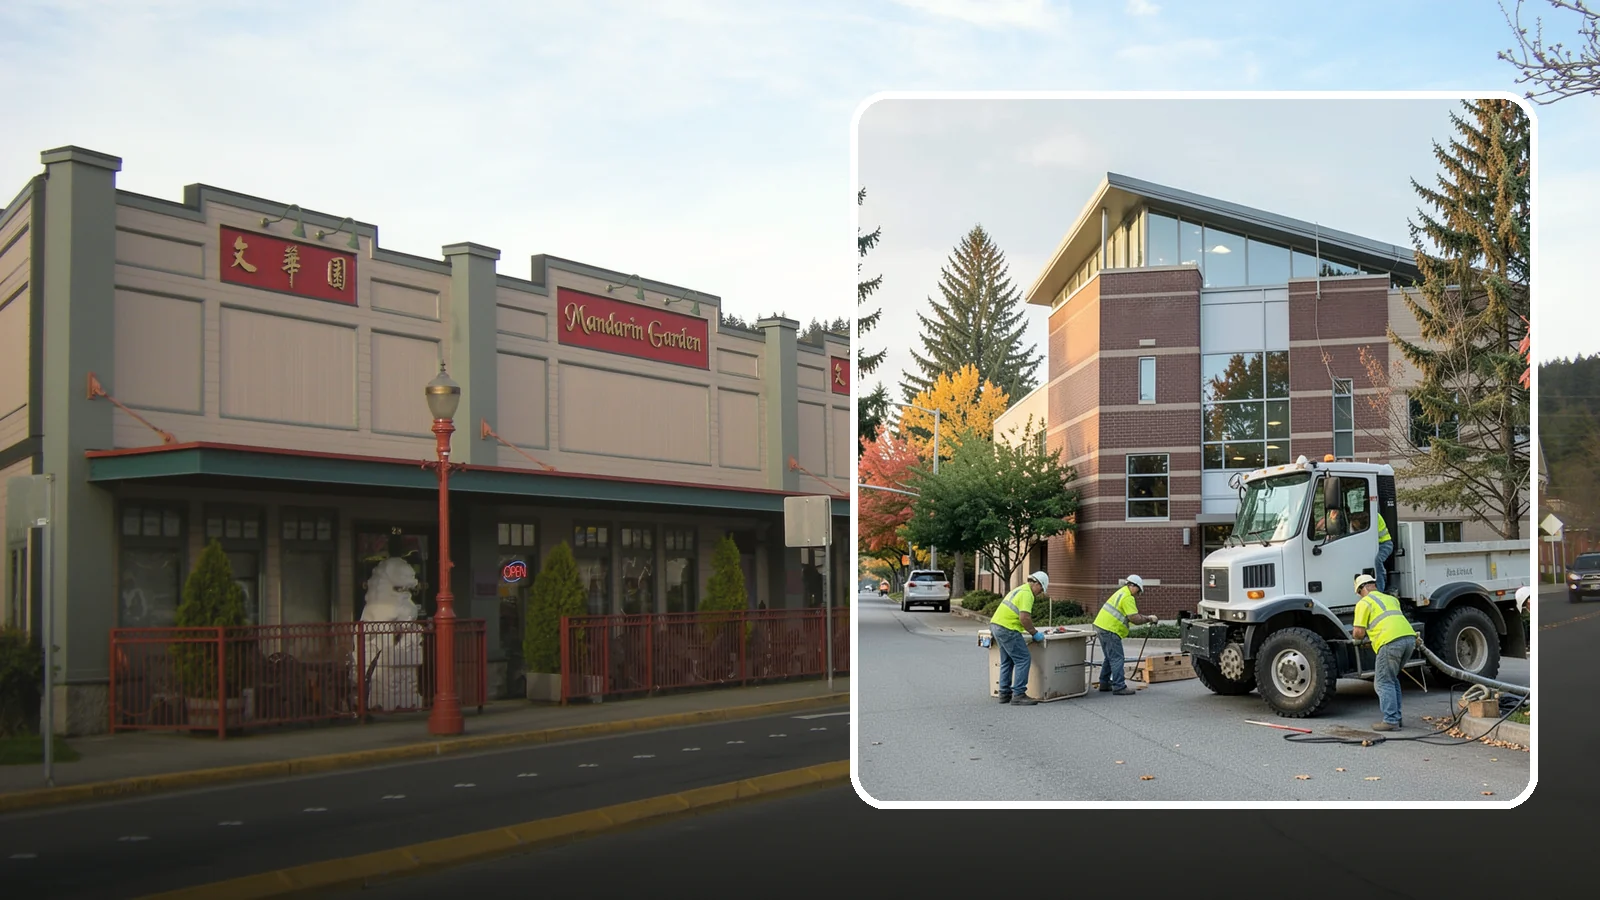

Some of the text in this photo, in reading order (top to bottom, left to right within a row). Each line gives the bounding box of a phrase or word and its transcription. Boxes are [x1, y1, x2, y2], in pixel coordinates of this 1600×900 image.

[230, 235, 346, 291] 文華園
[564, 302, 701, 352] Mandarin Garden
[503, 565, 527, 578] OPEN
